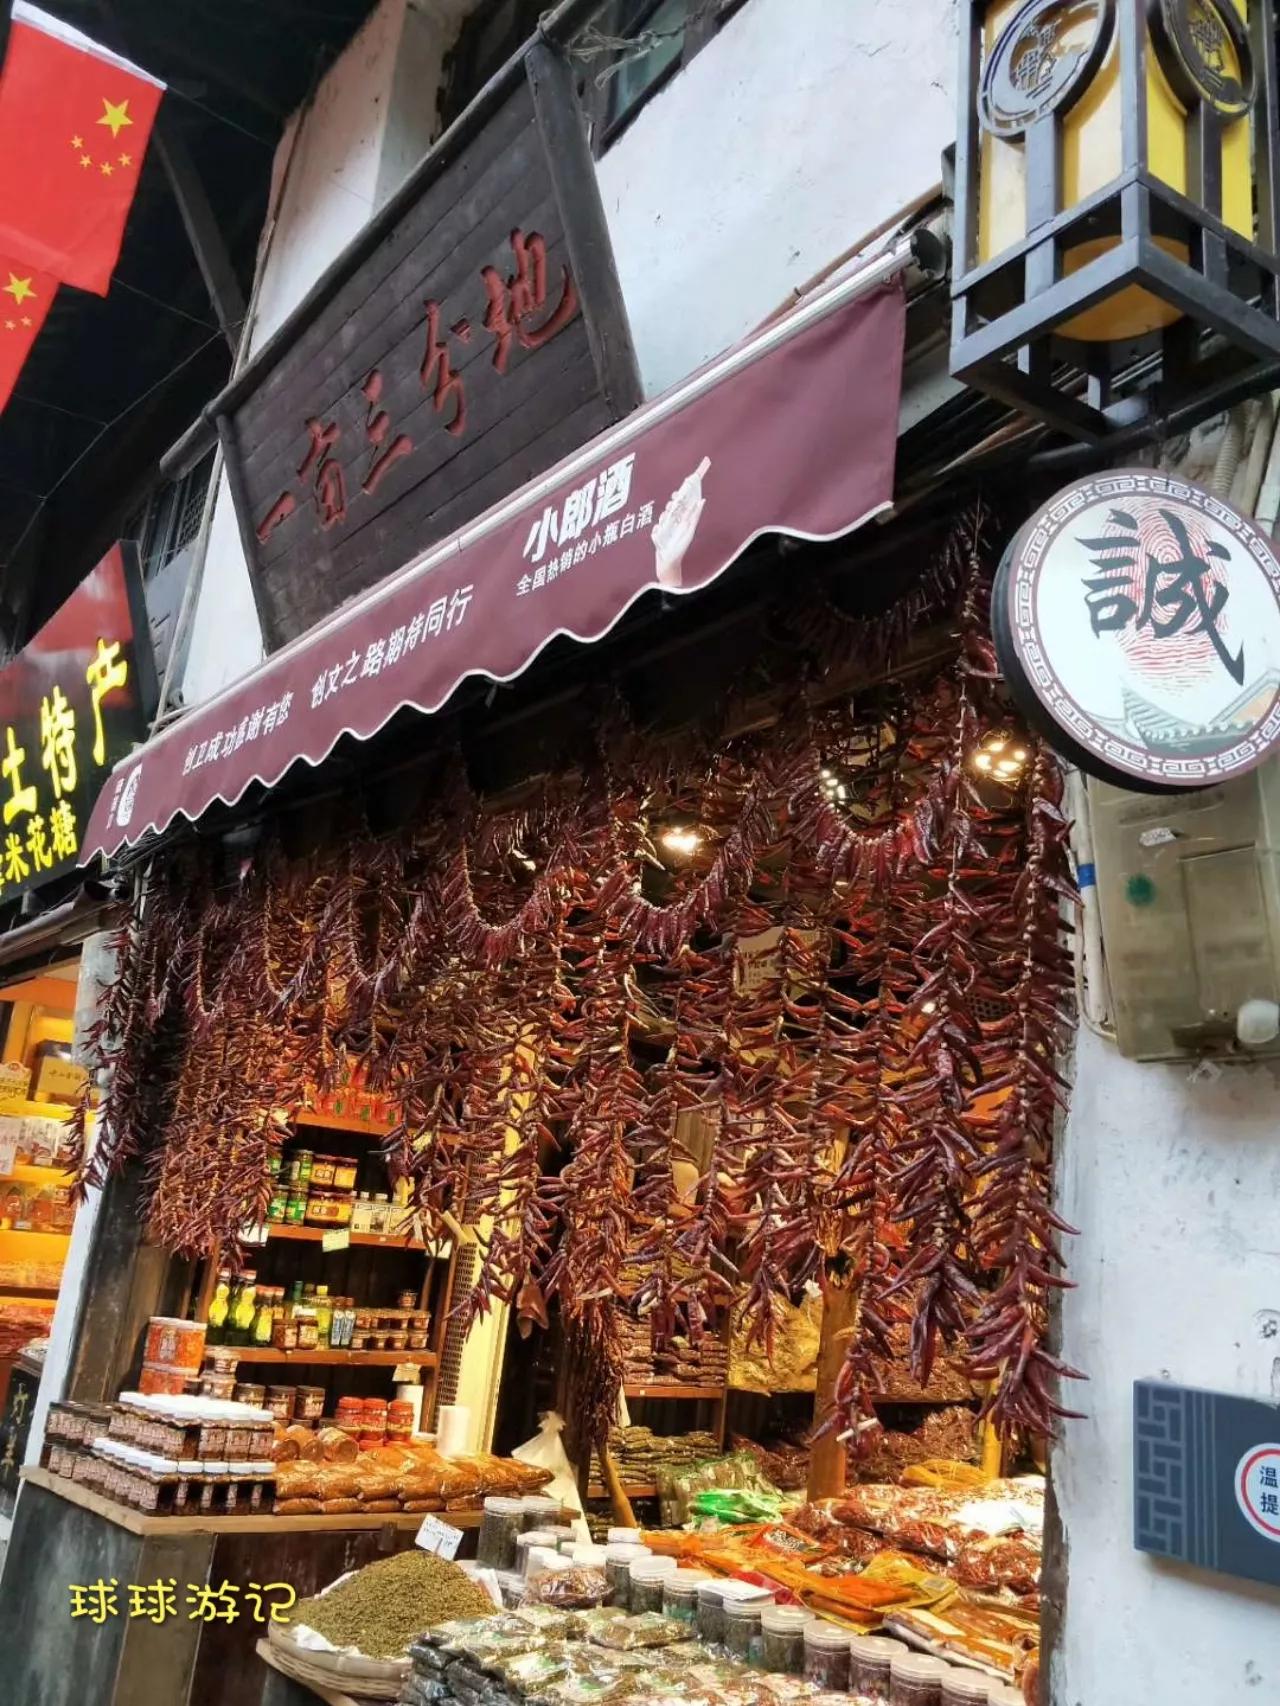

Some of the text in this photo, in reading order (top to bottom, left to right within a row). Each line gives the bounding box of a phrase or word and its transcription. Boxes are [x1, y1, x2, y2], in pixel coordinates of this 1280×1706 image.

[516, 500, 655, 597] 全国热销的小瓶白酒
[522, 453, 636, 563] 小郎酒
[310, 584, 474, 709] 创文之路期待同行
[3, 638, 128, 825] 土特产
